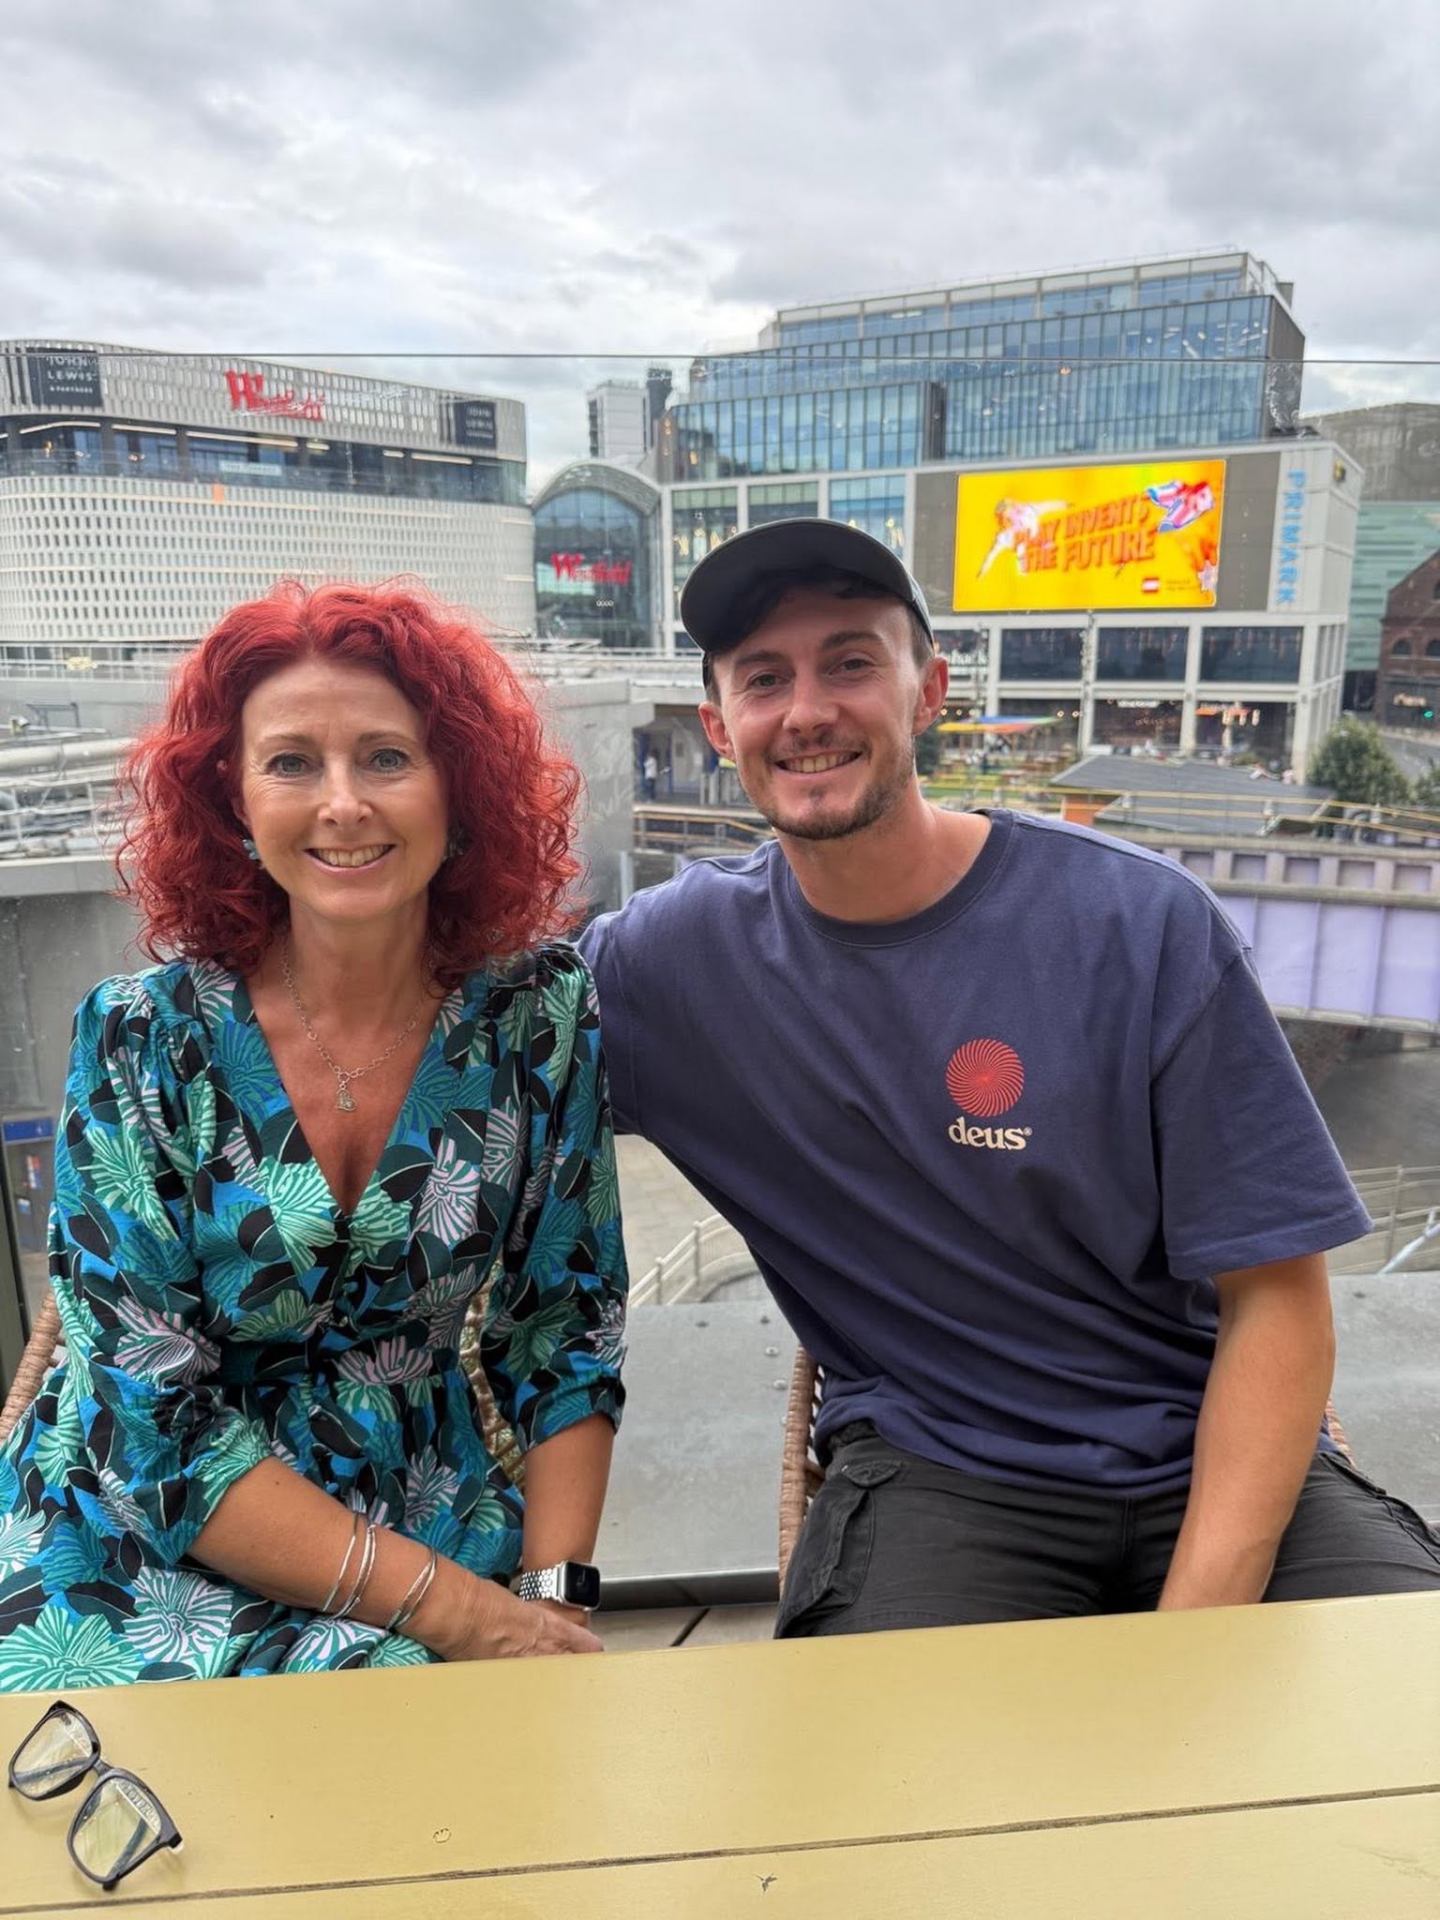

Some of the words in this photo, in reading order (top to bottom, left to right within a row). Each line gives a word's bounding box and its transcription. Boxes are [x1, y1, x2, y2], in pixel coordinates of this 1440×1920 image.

[47, 370, 93, 381] LEWIS
[1064, 529, 1155, 572] FUTURE
[1276, 469, 1307, 604] PRIMARK
